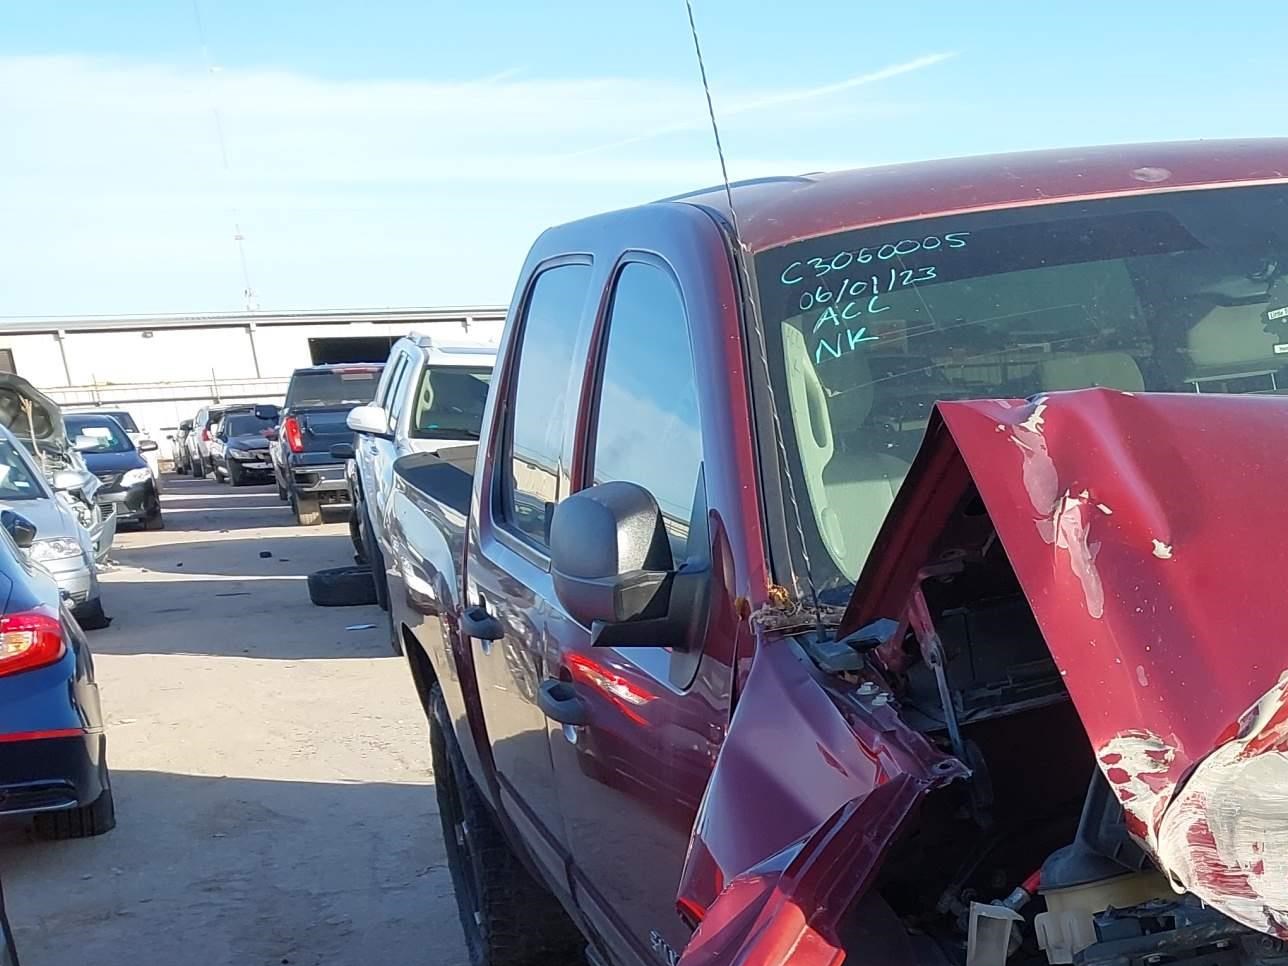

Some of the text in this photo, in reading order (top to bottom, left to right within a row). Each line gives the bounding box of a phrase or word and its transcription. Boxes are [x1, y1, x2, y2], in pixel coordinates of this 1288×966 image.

[780, 231, 971, 285] C3060005
[799, 266, 937, 310] 06/01/23
[815, 327, 880, 366] NK
